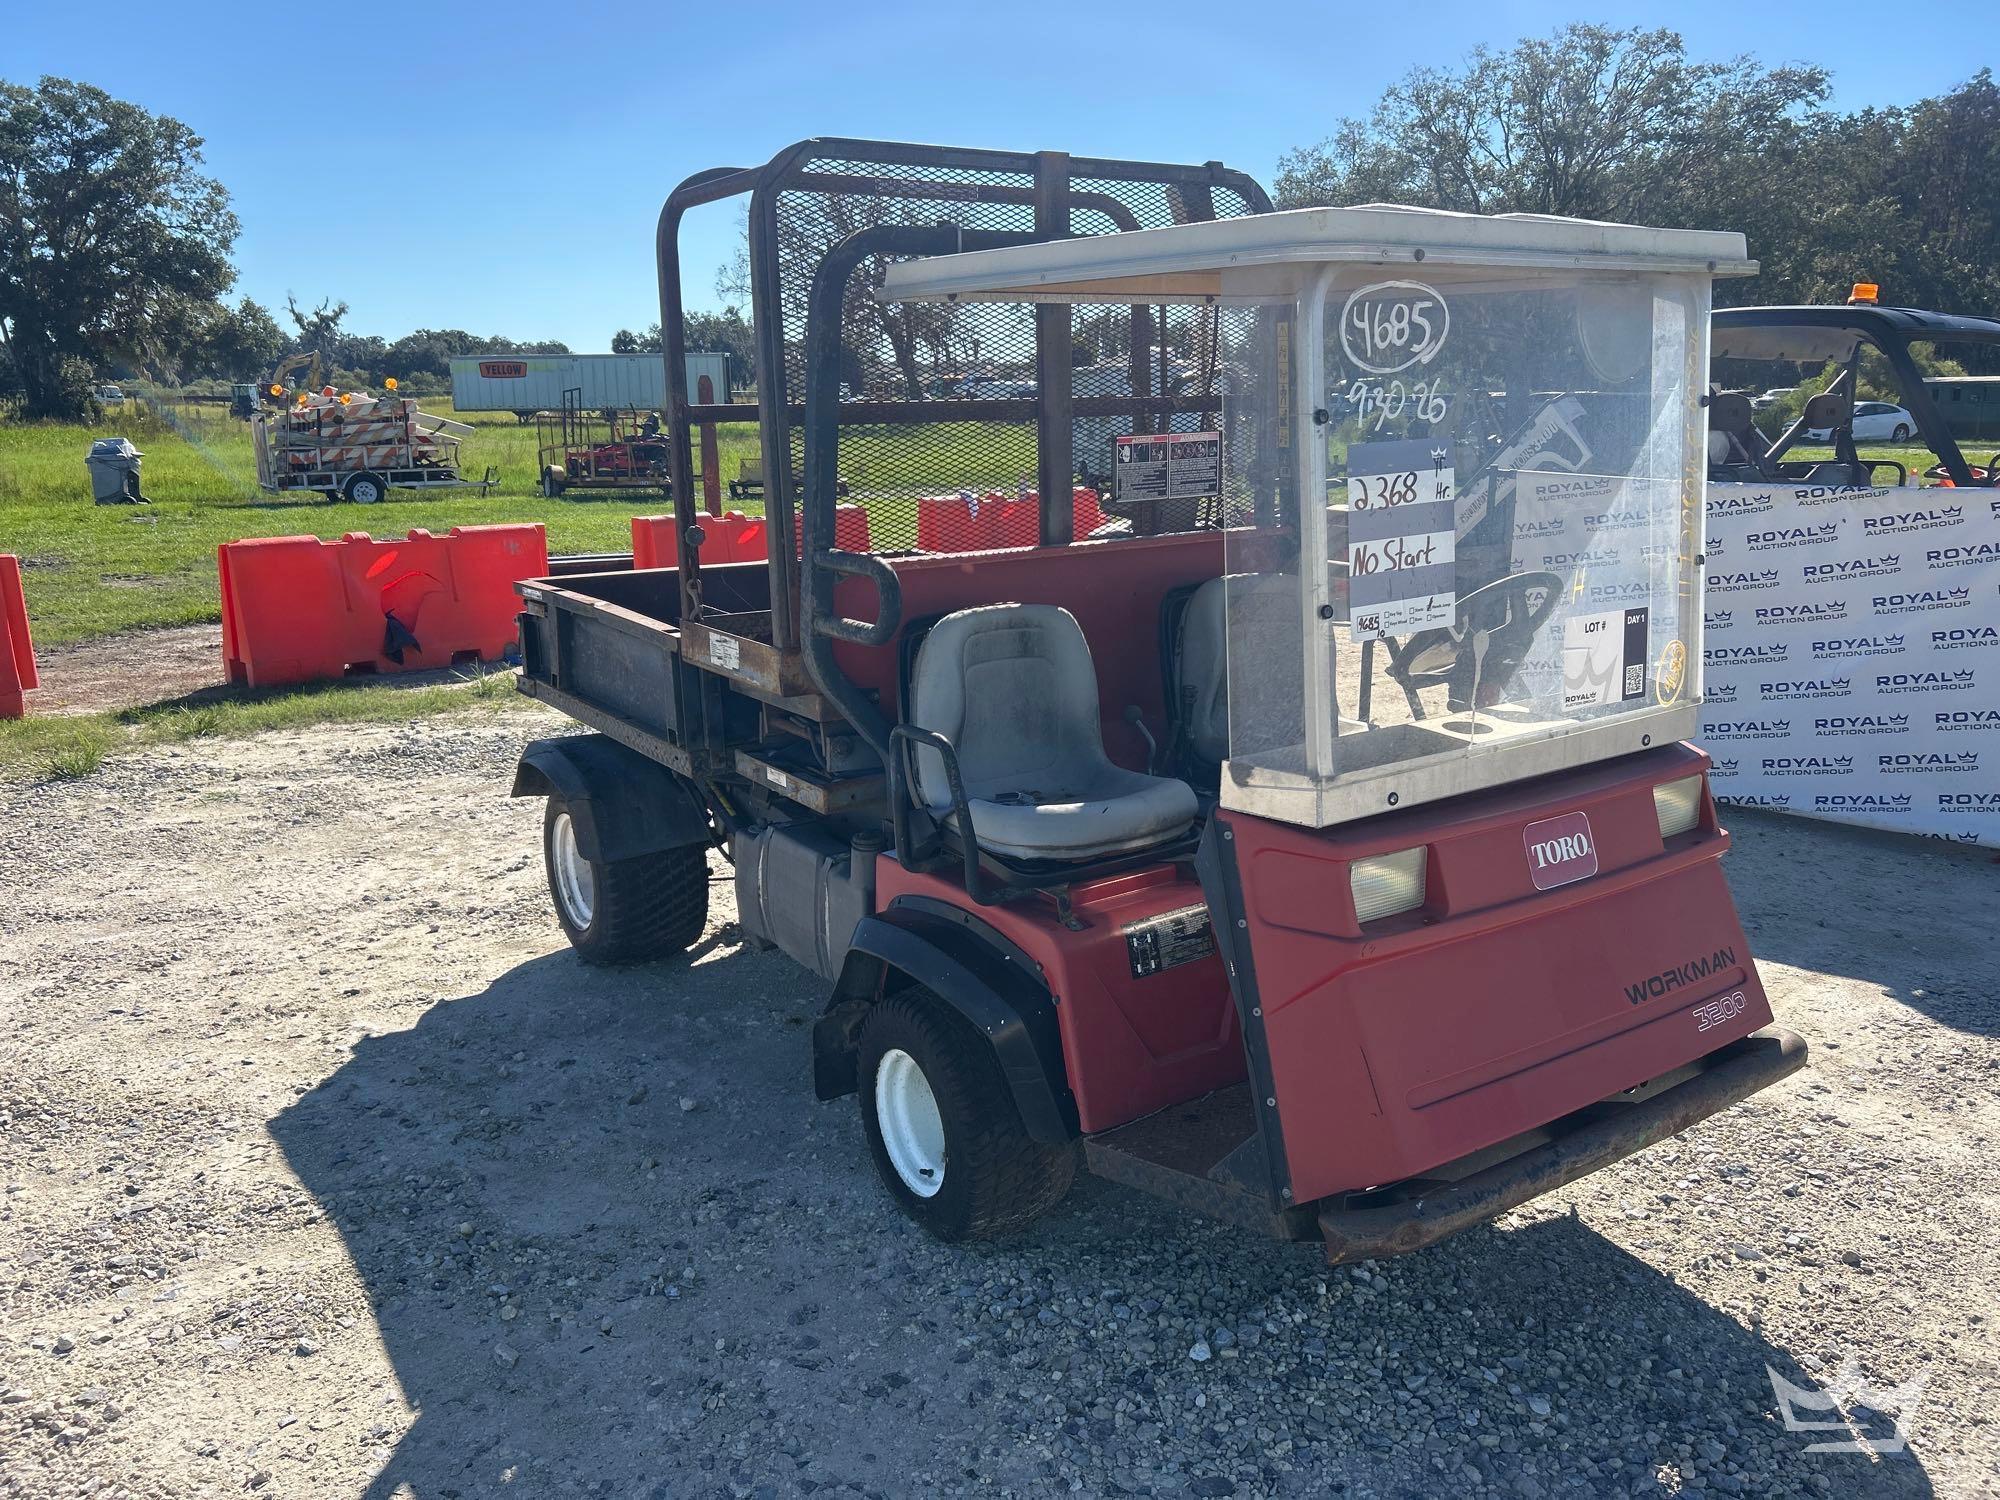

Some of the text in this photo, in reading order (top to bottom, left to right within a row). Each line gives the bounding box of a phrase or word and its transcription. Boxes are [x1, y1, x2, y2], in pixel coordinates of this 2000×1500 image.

[1353, 302, 1433, 357] 4685
[485, 364, 522, 375] YELLOW
[1436, 482, 1450, 500] Hr.
[1536, 481, 1594, 495] ROYAL
[1537, 489, 1612, 501] AUCTION GROUP
[1799, 490, 1890, 507] AUCTION GROUP
[1706, 497, 1754, 511] OYAL
[1735, 504, 1774, 516] GROUP
[1583, 511, 1646, 525] ROYAL
[1863, 510, 1942, 529] ROYAL
[1515, 521, 1548, 533] YAL
[1865, 518, 1966, 537] AUCTION GROUP
[1746, 526, 1818, 544] ROYAL
[1748, 535, 1839, 551] AUCTION GROUP
[1353, 535, 1436, 577] No Start
[1542, 551, 1604, 565] ROYAL
[1928, 556, 1983, 569] AUCTION
[1803, 559, 1879, 577] ROYAL
[1707, 572, 1760, 586] OYAL
[1804, 567, 1902, 584] AUCTION GROUP
[1591, 582, 1655, 596] ROYAL
[1705, 581, 1780, 593] UCTION GROUP
[1872, 590, 1948, 608] ROYAL
[1755, 604, 1826, 618] ROYAL
[1874, 600, 1971, 616] AUCTION GROUP
[1627, 615, 1640, 625] DAY
[1704, 622, 1734, 630] ROUP
[1757, 613, 1848, 626] AUCTION GROUP
[1584, 622, 1600, 634] LOT
[1932, 627, 1998, 642] ROYA
[1812, 637, 1884, 651] ROYAL
[1933, 640, 1988, 651] AUCTION
[1703, 646, 1769, 660] ROYAL
[1750, 655, 1788, 664] GROUP
[1813, 647, 1906, 660] AUCTION GROUP
[1876, 672, 1953, 686] ROYAL
[1760, 680, 1831, 693] ROYAL
[1877, 682, 1976, 694] AUCTION GROUP
[1565, 693, 1591, 704] ROYAL
[1761, 690, 1852, 701] AUCTION GROUP
[1814, 715, 1889, 729] ROYAL
[1935, 710, 2000, 724] ROYA
[1703, 721, 1772, 734] ROYAL
[1815, 726, 1910, 737] AUCTION GROUP
[1936, 723, 1992, 732] AUCTION
[1703, 731, 1791, 741] AUCTION GROUP
[1761, 758, 1834, 769] ROYAL
[1878, 753, 1957, 765] ROYAL
[1762, 768, 1854, 777] AUCTION GROUP
[1879, 765, 1979, 774] AUCTION GROUP
[1712, 795, 1770, 805] OYAL
[1815, 795, 1890, 805] ROYAL
[1938, 793, 2000, 805] ROYA
[1531, 832, 1589, 869] TORO
[1624, 946, 1737, 1005] WORKMAN
[1693, 991, 1746, 1032] 3200
